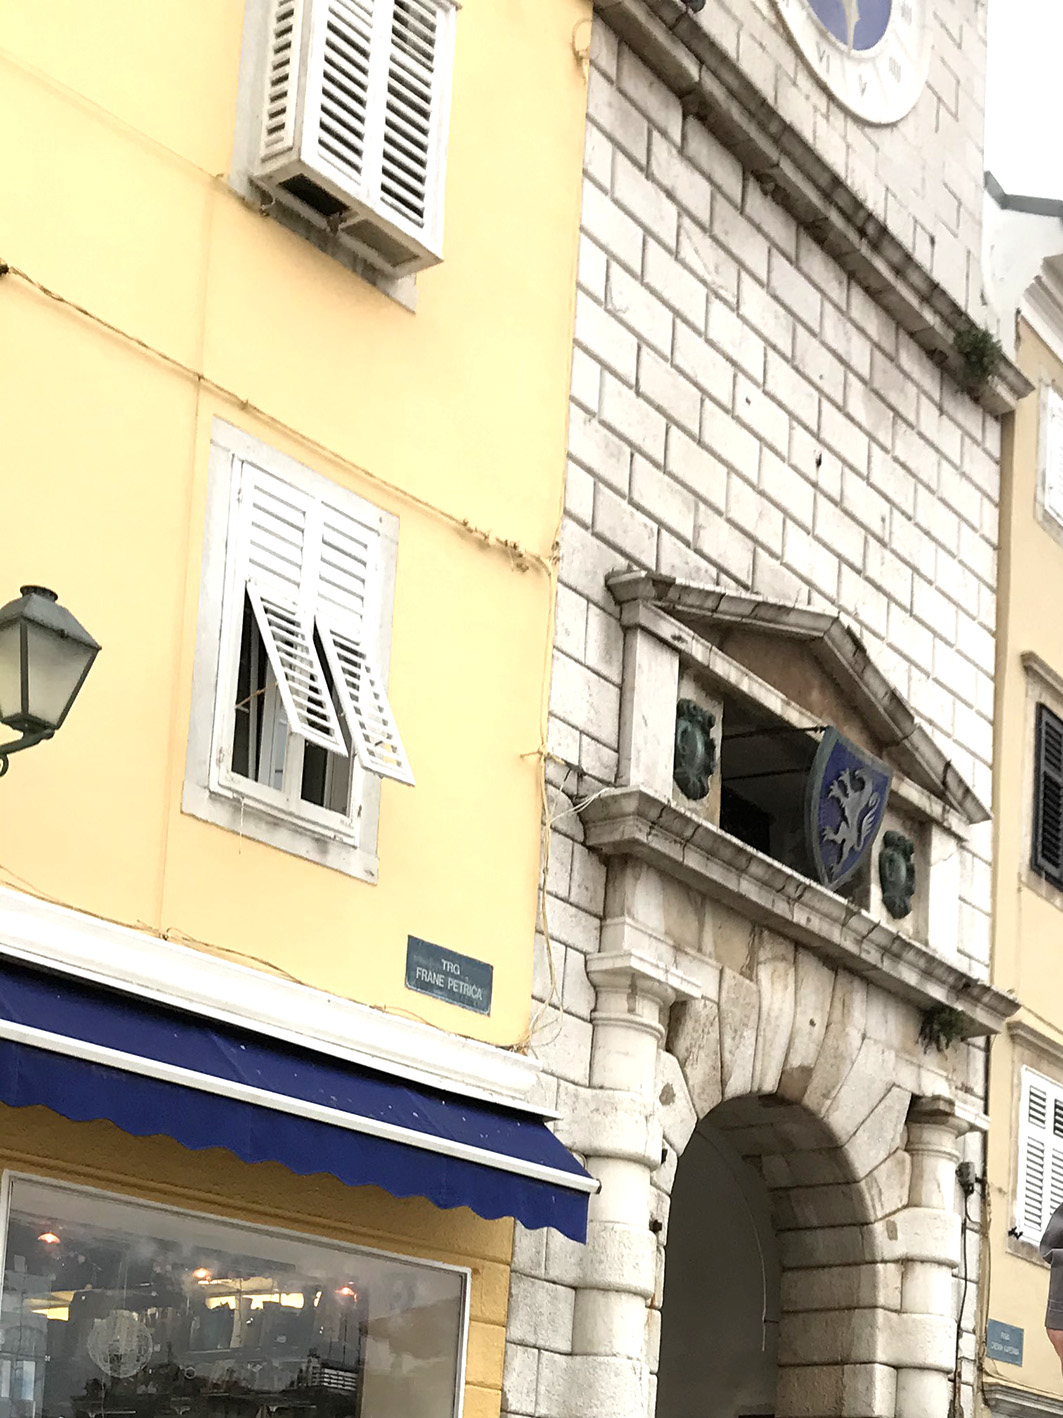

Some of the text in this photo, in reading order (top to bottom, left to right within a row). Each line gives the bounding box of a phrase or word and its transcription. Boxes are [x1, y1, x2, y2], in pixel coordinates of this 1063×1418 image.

[441, 958, 460, 975] TRG
[415, 966, 483, 1001] FRANE PETRIĆA
